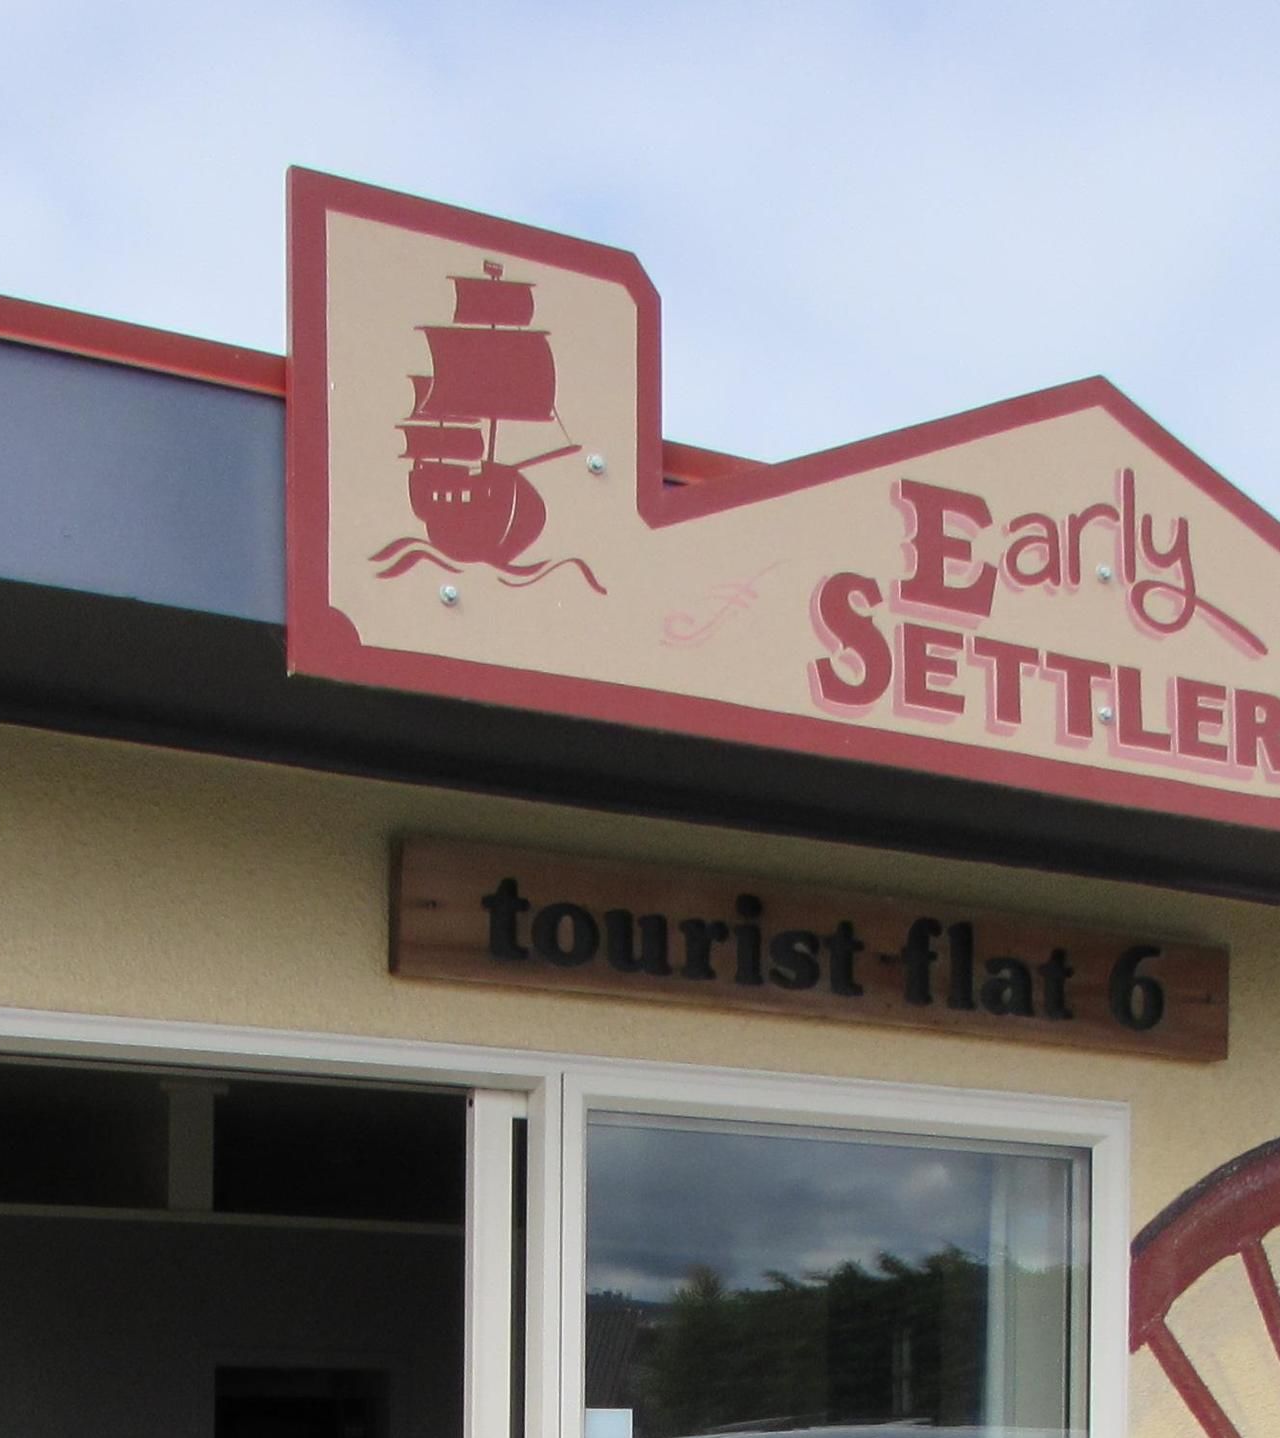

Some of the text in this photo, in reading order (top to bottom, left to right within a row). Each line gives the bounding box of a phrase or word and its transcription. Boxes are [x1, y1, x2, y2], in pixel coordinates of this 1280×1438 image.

[893, 467, 1269, 655] Early
[482, 877, 1165, 1031] tourist flat 6
